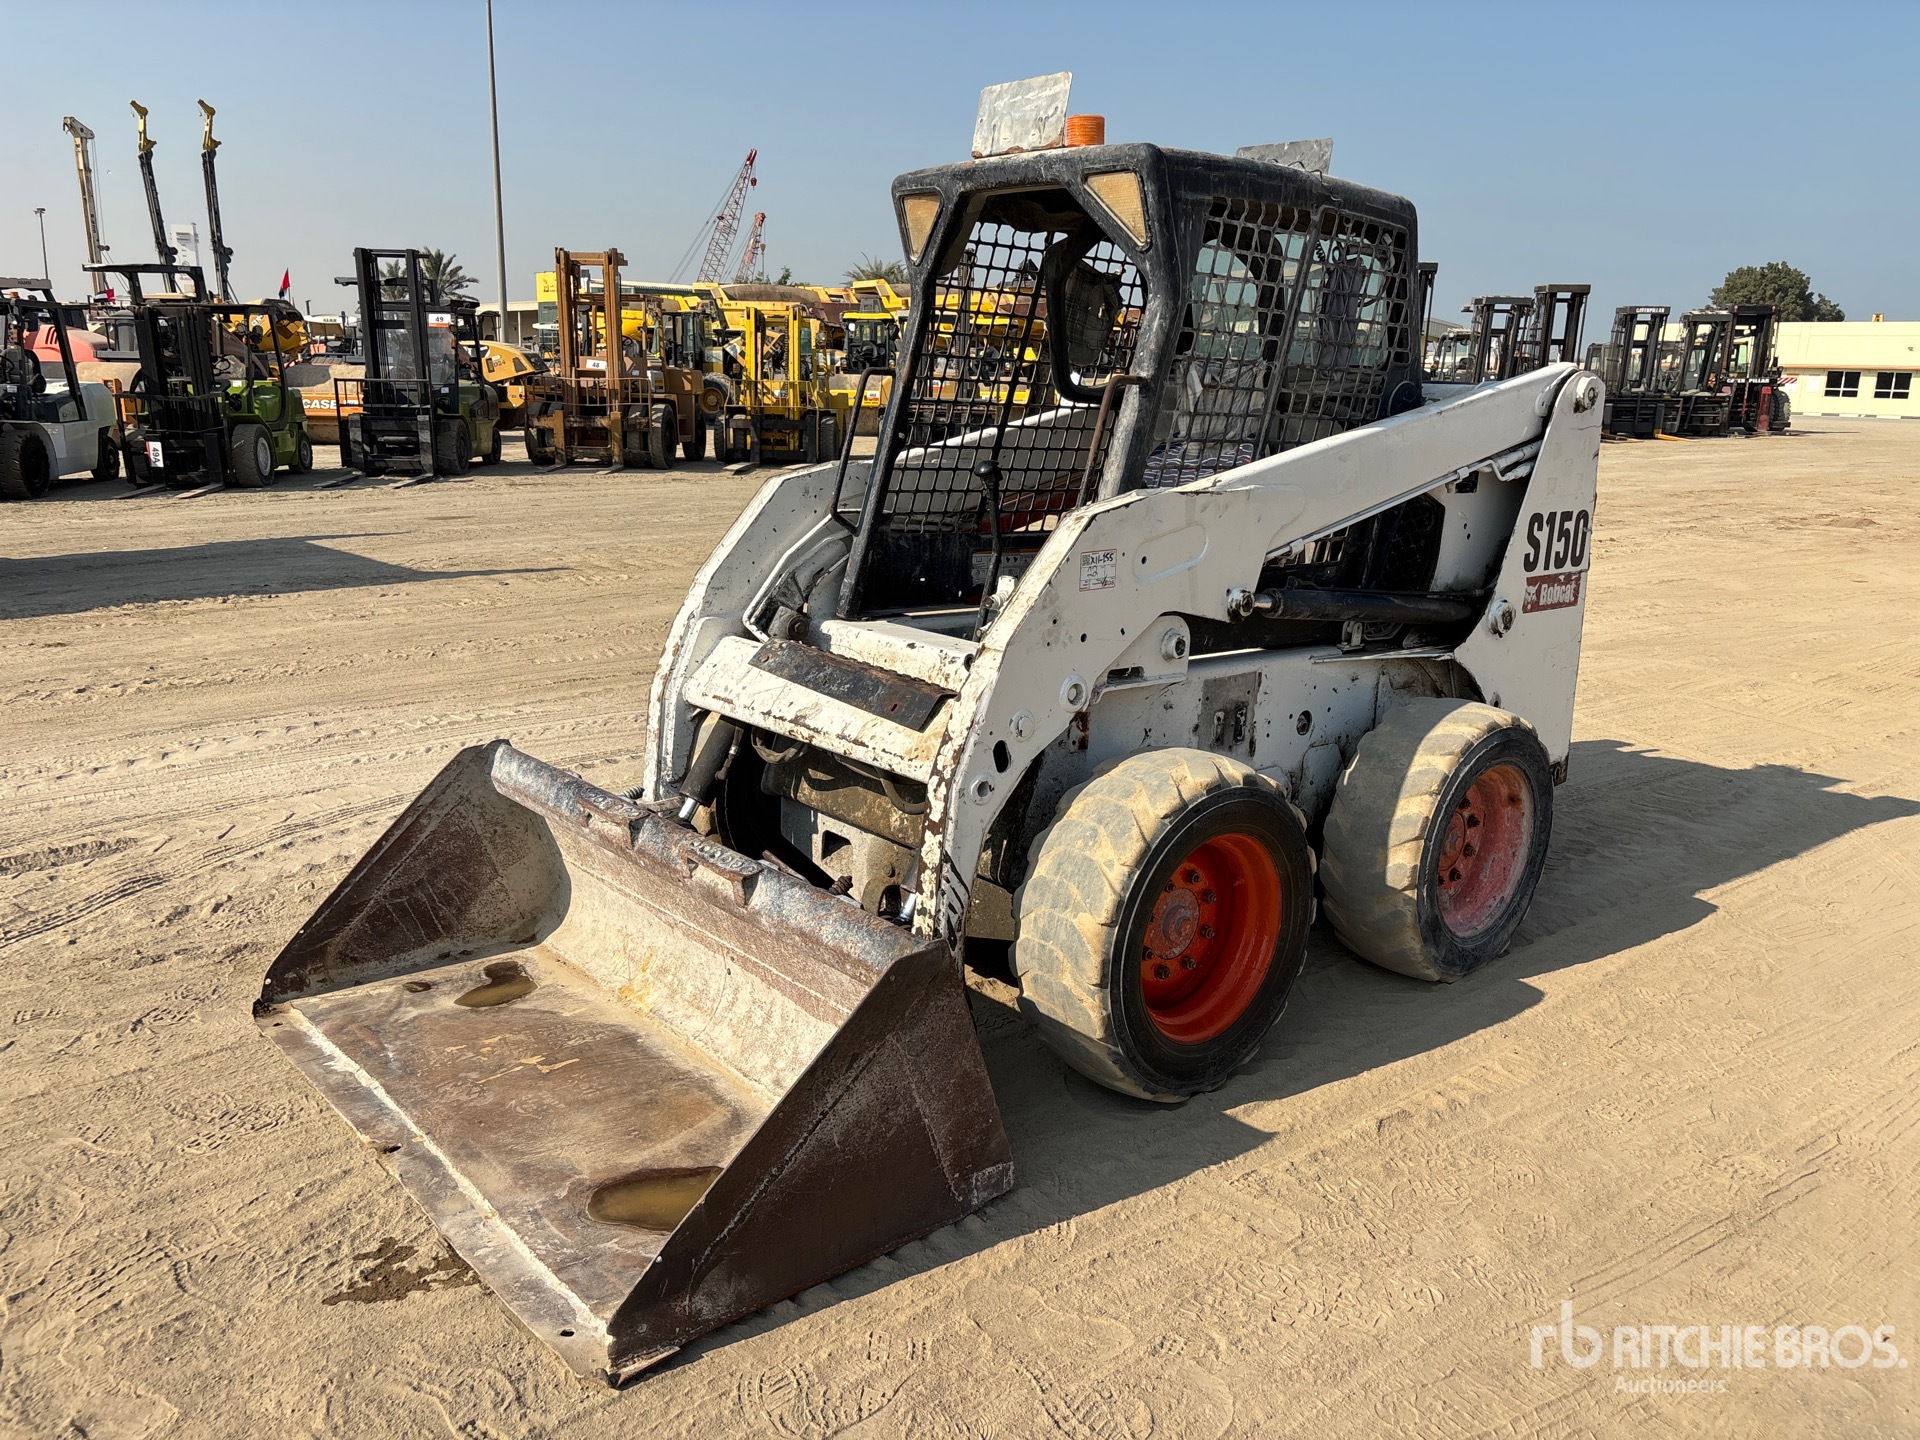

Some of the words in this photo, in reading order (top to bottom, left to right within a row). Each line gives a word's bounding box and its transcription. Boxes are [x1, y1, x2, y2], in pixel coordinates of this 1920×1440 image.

[302, 398, 338, 410] CASE
[151, 446, 161, 464] 49A
[1523, 509, 1590, 573] S150
[1538, 581, 1578, 606] Bobcat
